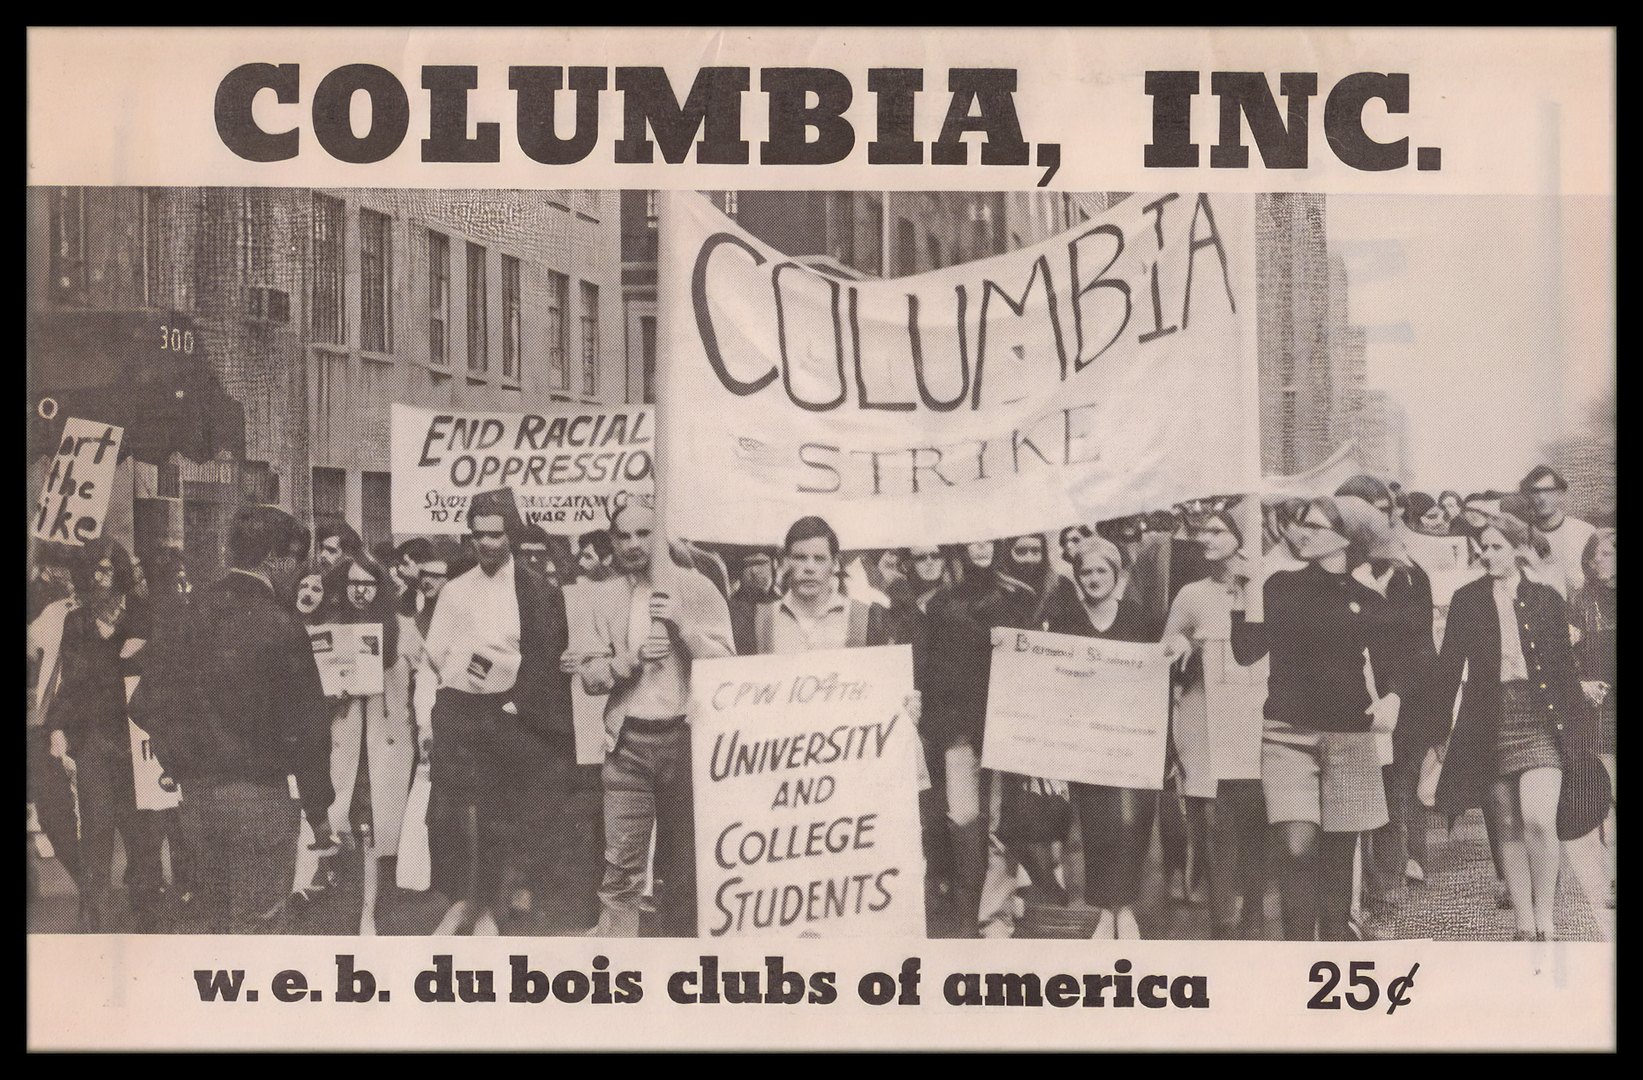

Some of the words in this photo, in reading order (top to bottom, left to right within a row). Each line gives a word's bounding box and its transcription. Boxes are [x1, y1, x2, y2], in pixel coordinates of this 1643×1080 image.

[214, 63, 1061, 187] COLUMBIA,
[1144, 71, 1441, 171] INC.
[691, 192, 1236, 412] COLUMBIA
[160, 325, 195, 354] 300
[418, 415, 505, 467] END
[514, 412, 652, 451] RACIAL
[797, 403, 1100, 495] STRIKE
[450, 449, 656, 488] OPPRESSIO
[526, 510, 567, 523] WAR
[574, 508, 594, 522] IN
[709, 714, 900, 782] UNIVERSITY
[771, 775, 836, 810] AND
[715, 813, 878, 870] COLLEGE
[710, 868, 900, 937] STUDENTS
[415, 955, 496, 1002] du
[510, 955, 643, 1003] bois
[668, 956, 837, 1004] clubs
[858, 958, 920, 1005] of
[944, 959, 1209, 1008] america
[1307, 961, 1419, 1014] 25¢
